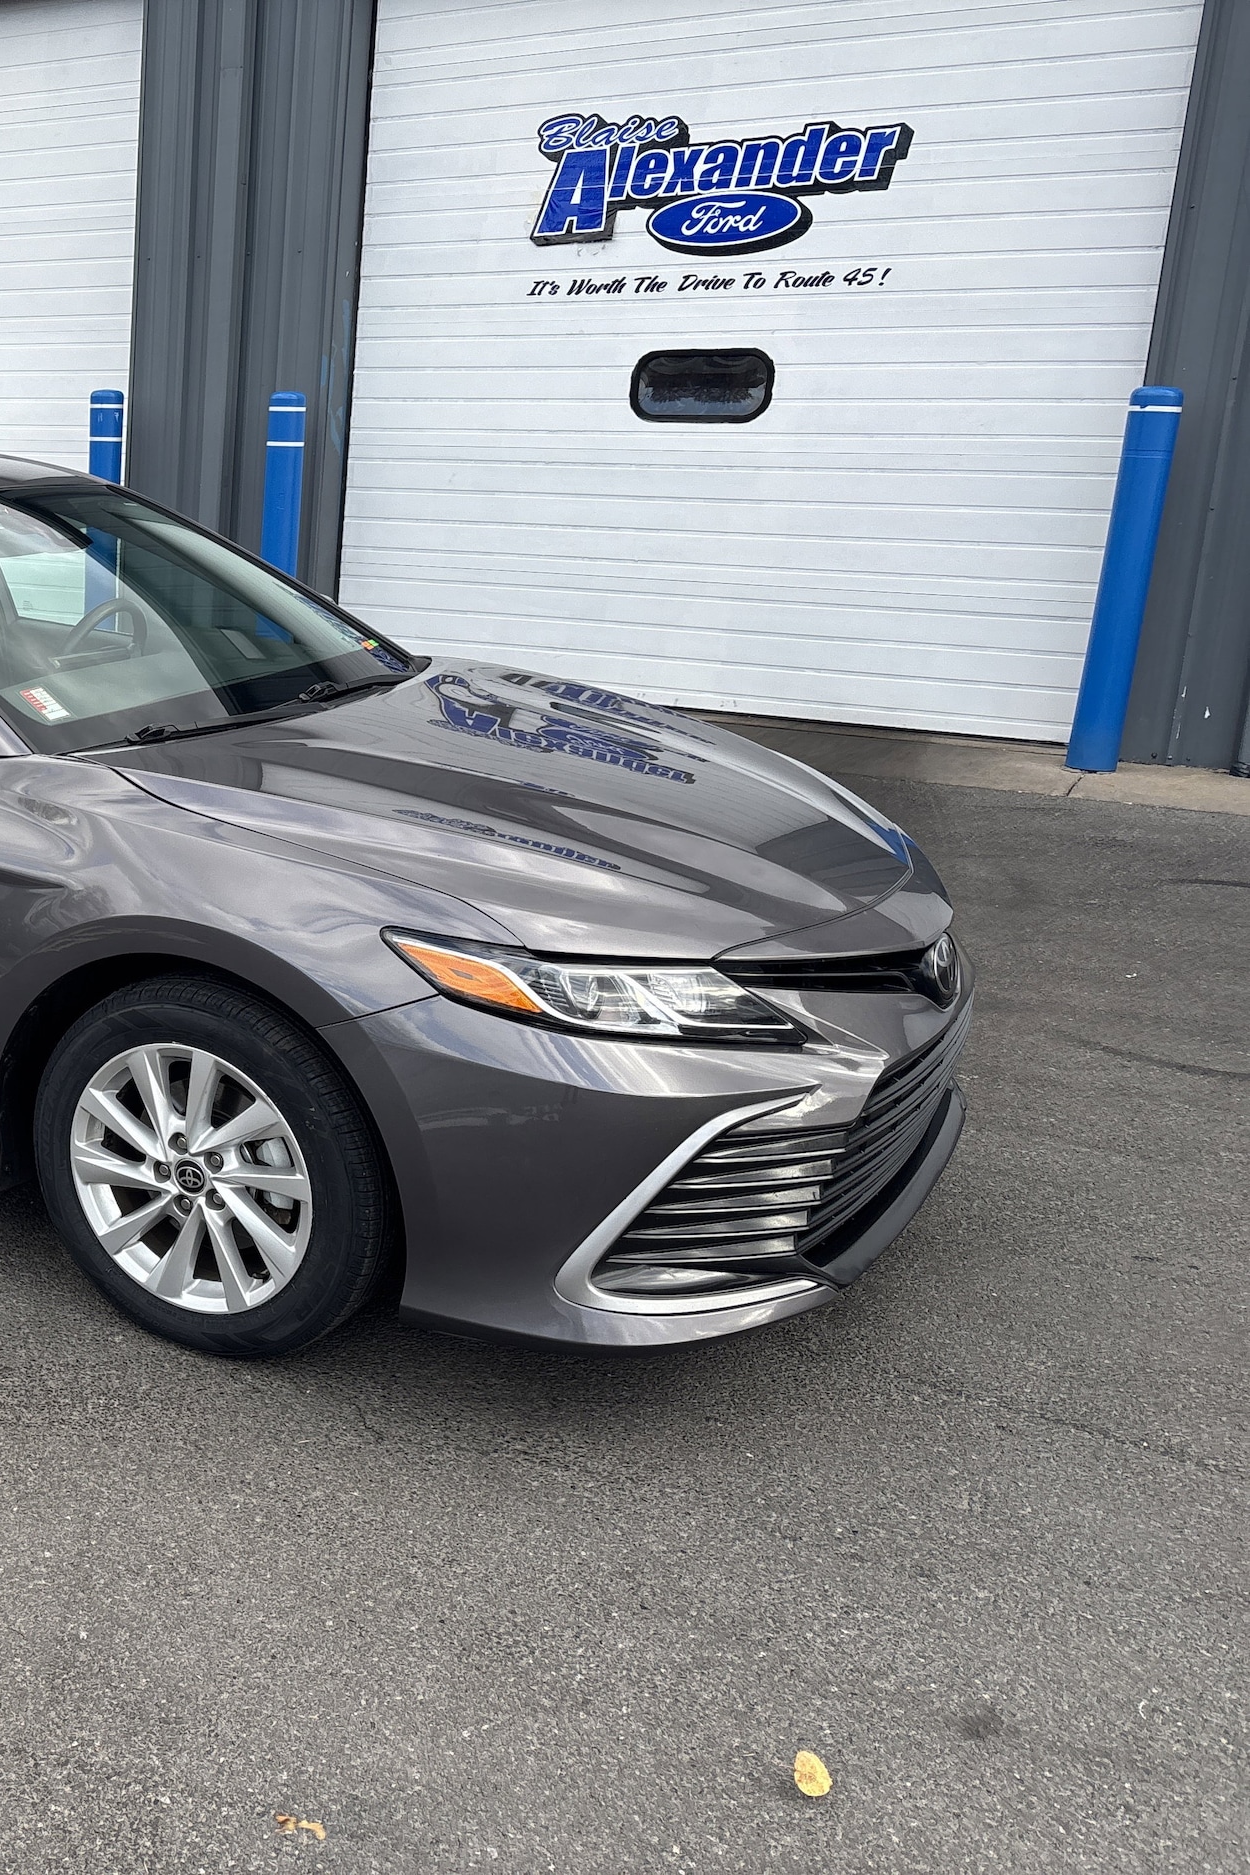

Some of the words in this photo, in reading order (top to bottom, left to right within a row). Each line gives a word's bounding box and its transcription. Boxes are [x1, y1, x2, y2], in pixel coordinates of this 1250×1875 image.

[539, 114, 679, 151] Blaise
[533, 123, 904, 238] Alexander
[680, 201, 767, 236] Ford
[526, 280, 560, 296] It's
[566, 276, 628, 296] Worth
[634, 275, 668, 294] The
[677, 274, 736, 292] Drive
[743, 271, 767, 290] To
[773, 270, 836, 289] Route
